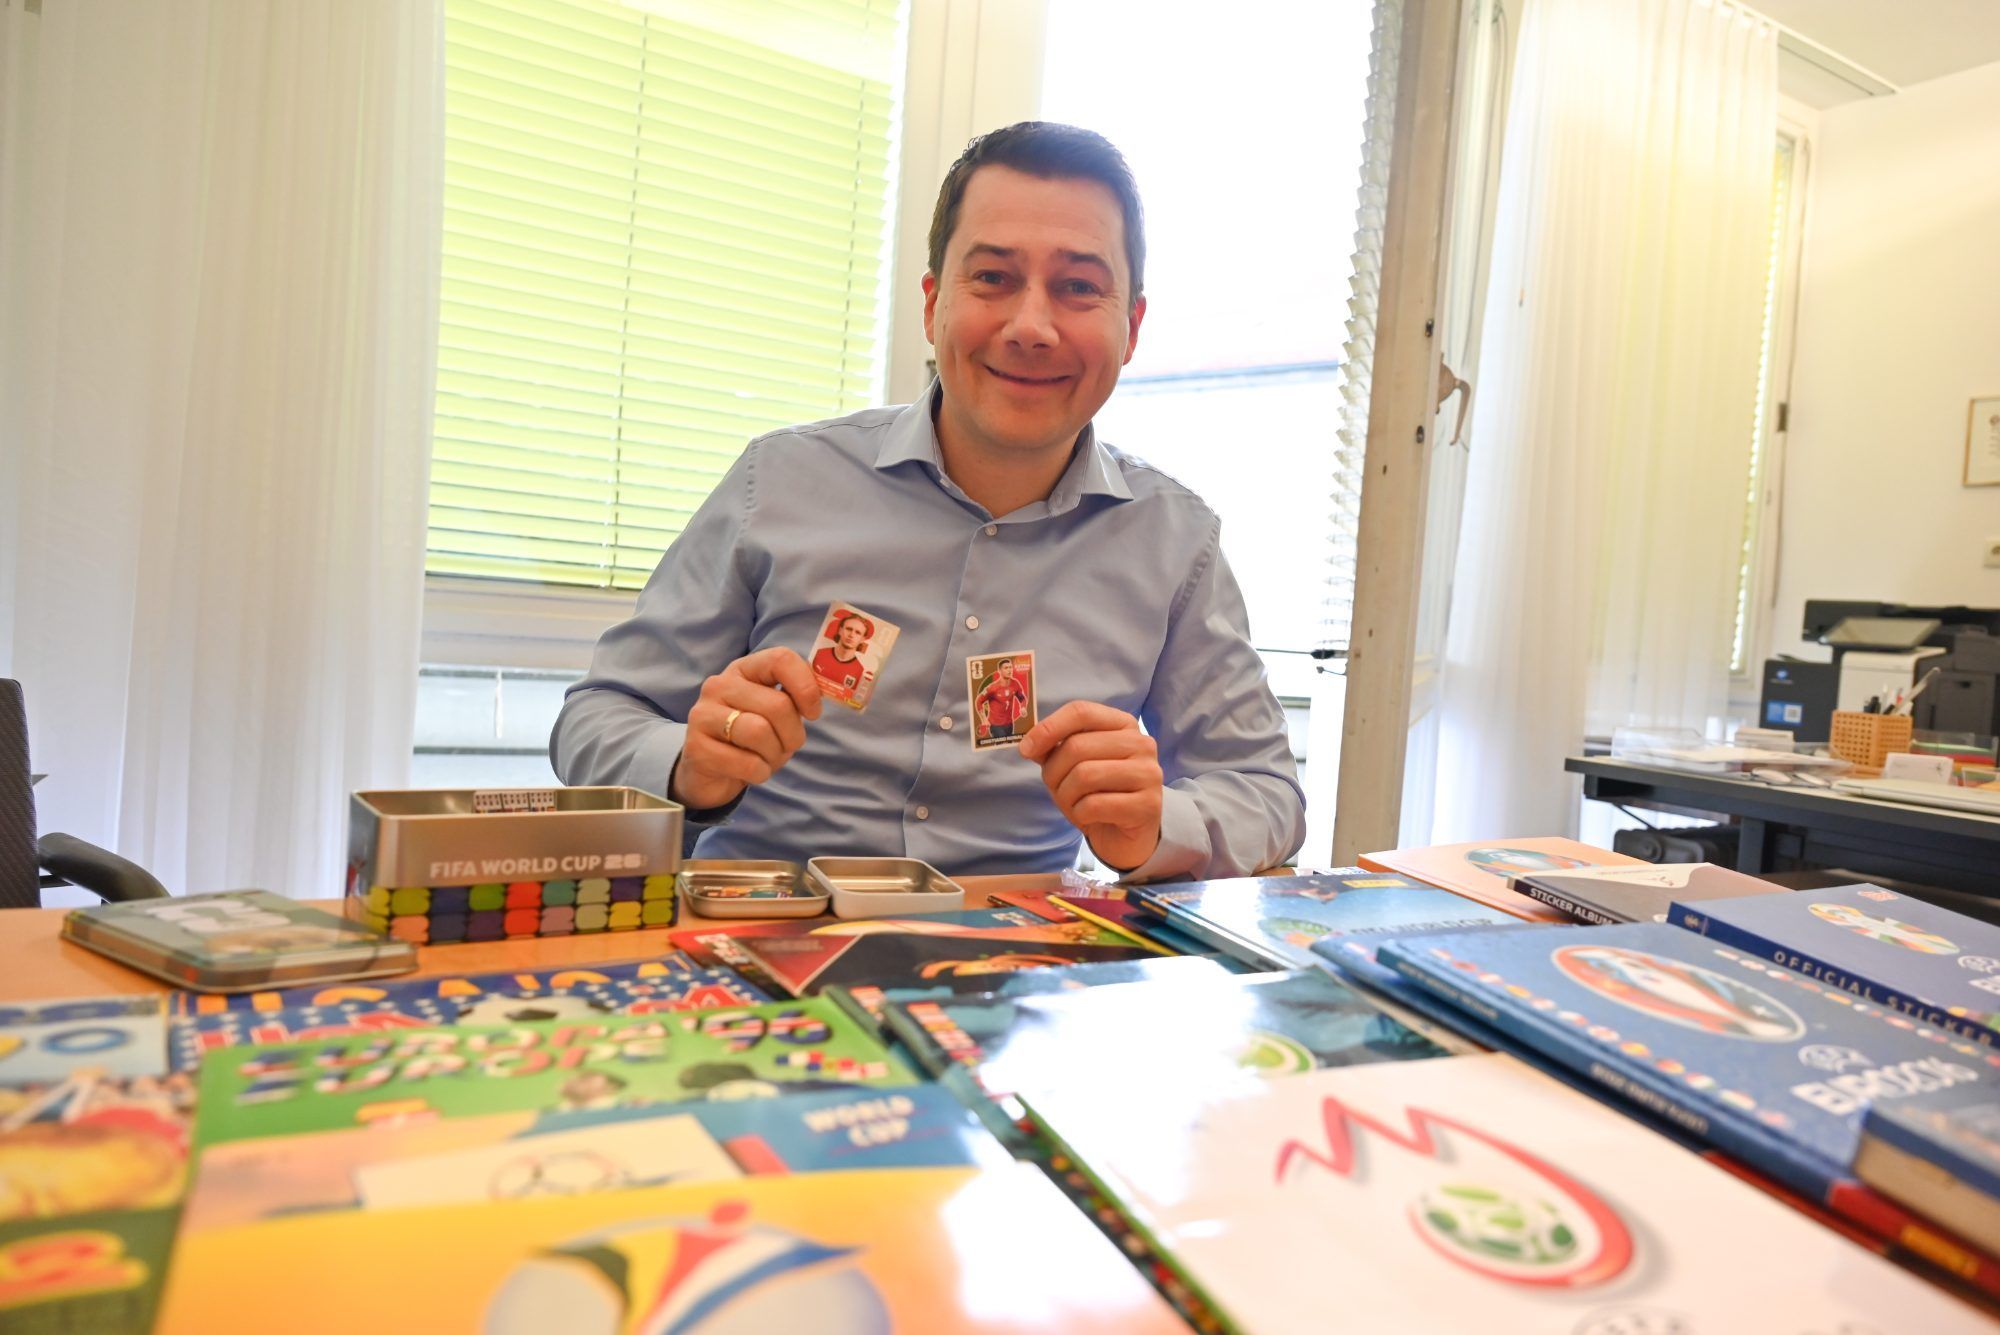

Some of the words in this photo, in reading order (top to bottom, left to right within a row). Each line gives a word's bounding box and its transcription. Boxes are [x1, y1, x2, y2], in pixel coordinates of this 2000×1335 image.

[429, 861, 477, 879] FIFA
[481, 858, 557, 876] WORLD
[561, 855, 602, 871] CUP
[1530, 887, 1573, 915] STICKER
[1773, 950, 1873, 1000] OFFICIAL
[1886, 996, 1993, 1046] STICKER
[803, 1095, 914, 1133] WORLD
[848, 1117, 909, 1147] CUP
